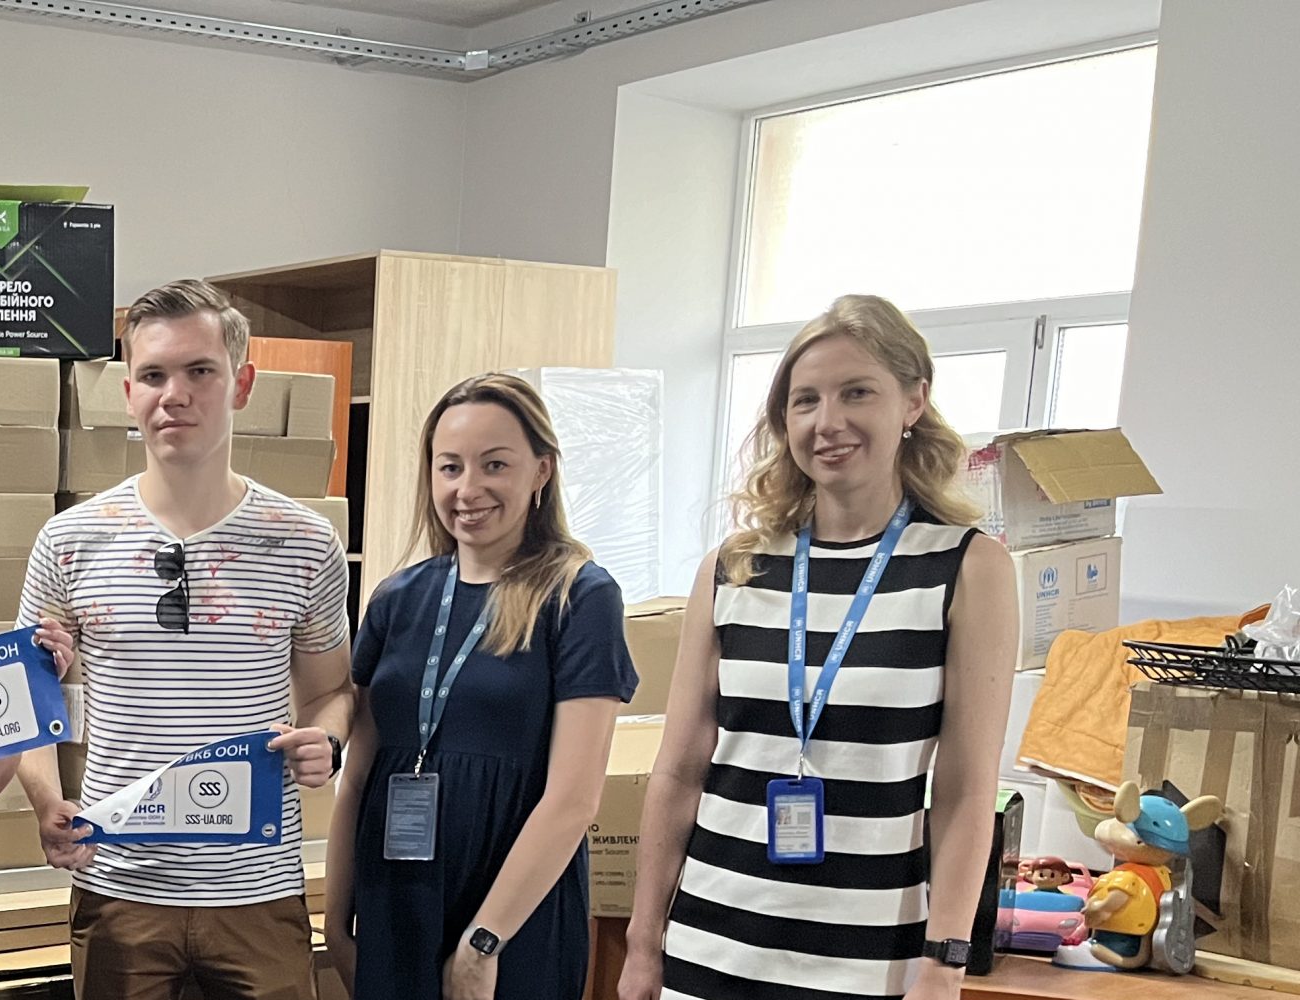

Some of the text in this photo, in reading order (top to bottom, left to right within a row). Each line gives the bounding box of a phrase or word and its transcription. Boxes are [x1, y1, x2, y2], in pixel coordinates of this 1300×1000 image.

[5, 330, 26, 338] Power
[26, 330, 48, 338] Source
[866, 552, 886, 583] UNHCR
[835, 619, 855, 652] UNHCR
[794, 630, 803, 661] UNHCR
[809, 688, 824, 721] UNHCR
[215, 744, 249, 758] ООН
[199, 781, 221, 796] SSS
[134, 804, 166, 814] HCR
[185, 814, 233, 825] SSS-UA.ORG
[592, 835, 640, 845] ЖИВЛЕН
